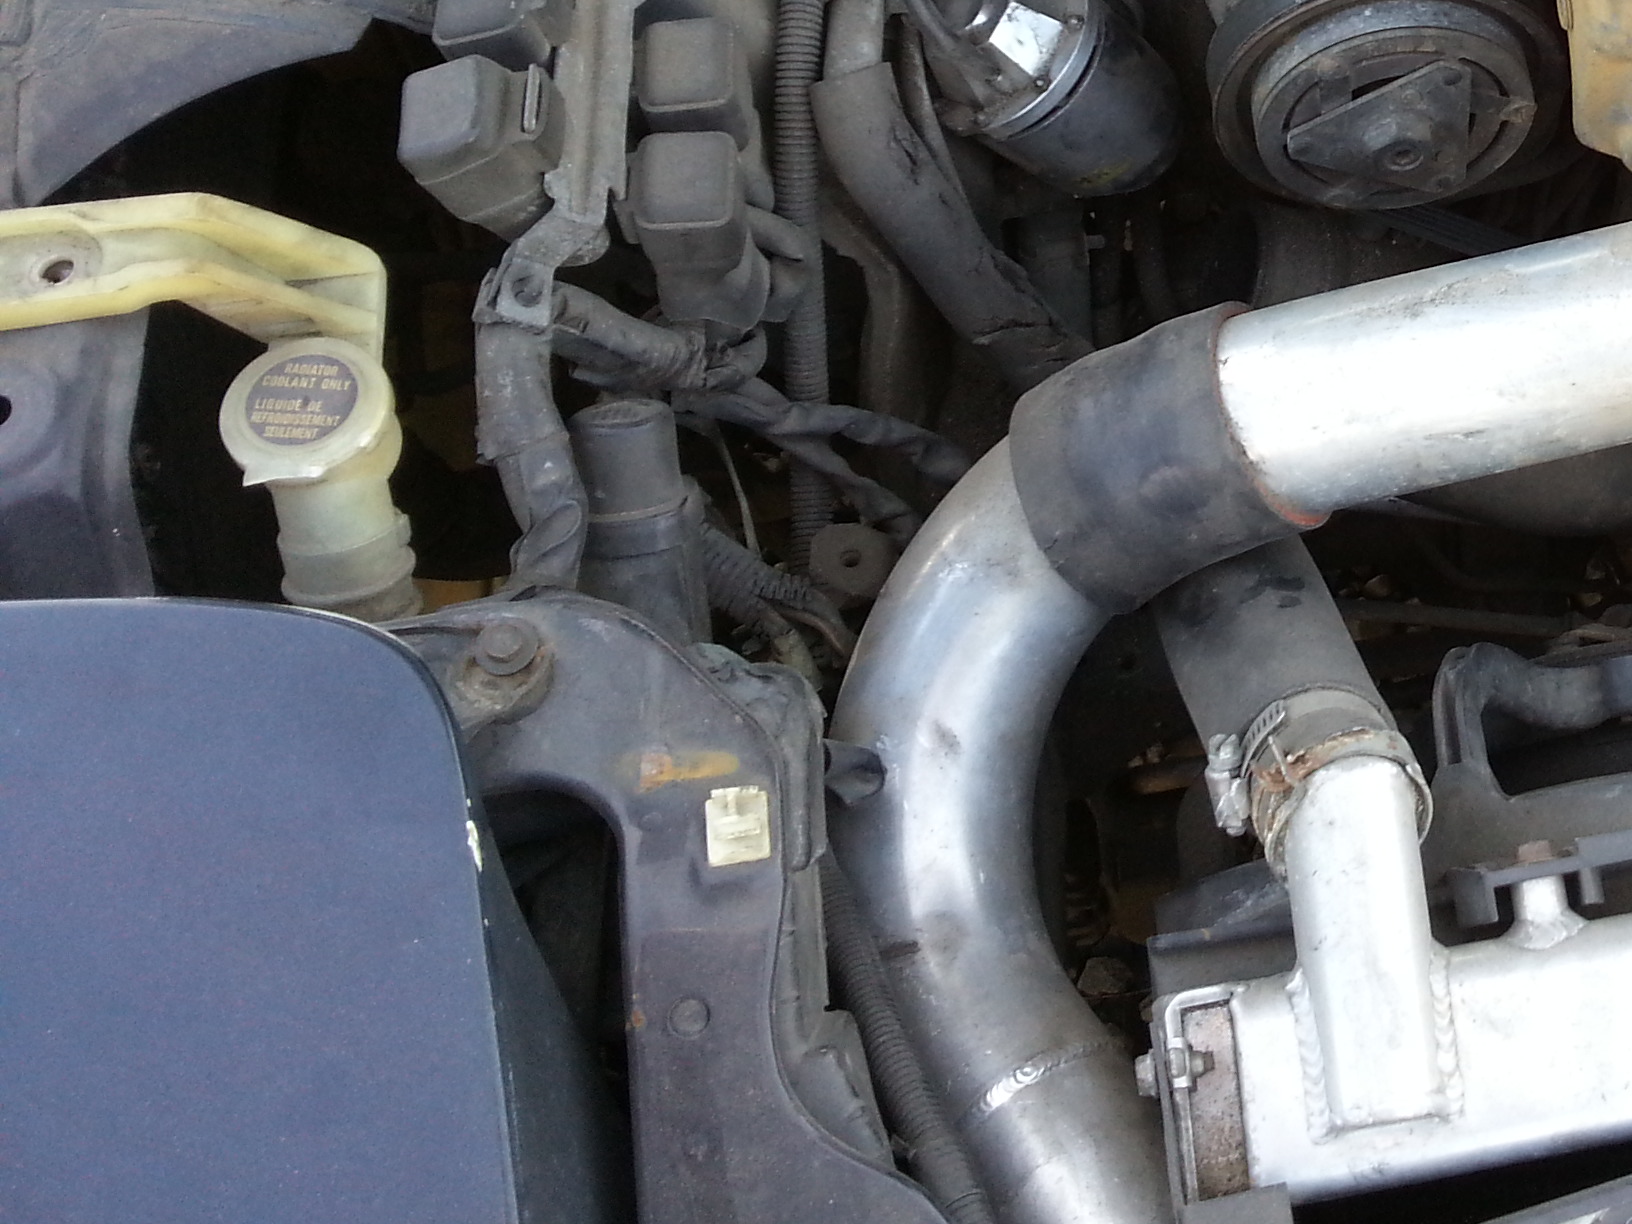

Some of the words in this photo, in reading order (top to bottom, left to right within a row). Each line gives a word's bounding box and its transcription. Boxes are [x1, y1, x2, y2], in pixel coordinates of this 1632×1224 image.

[284, 363, 339, 376] RADIATOR
[262, 375, 317, 389] COOLANT
[320, 378, 352, 391] ONLY
[255, 398, 303, 412] LIQUIDE
[307, 400, 323, 412] DE
